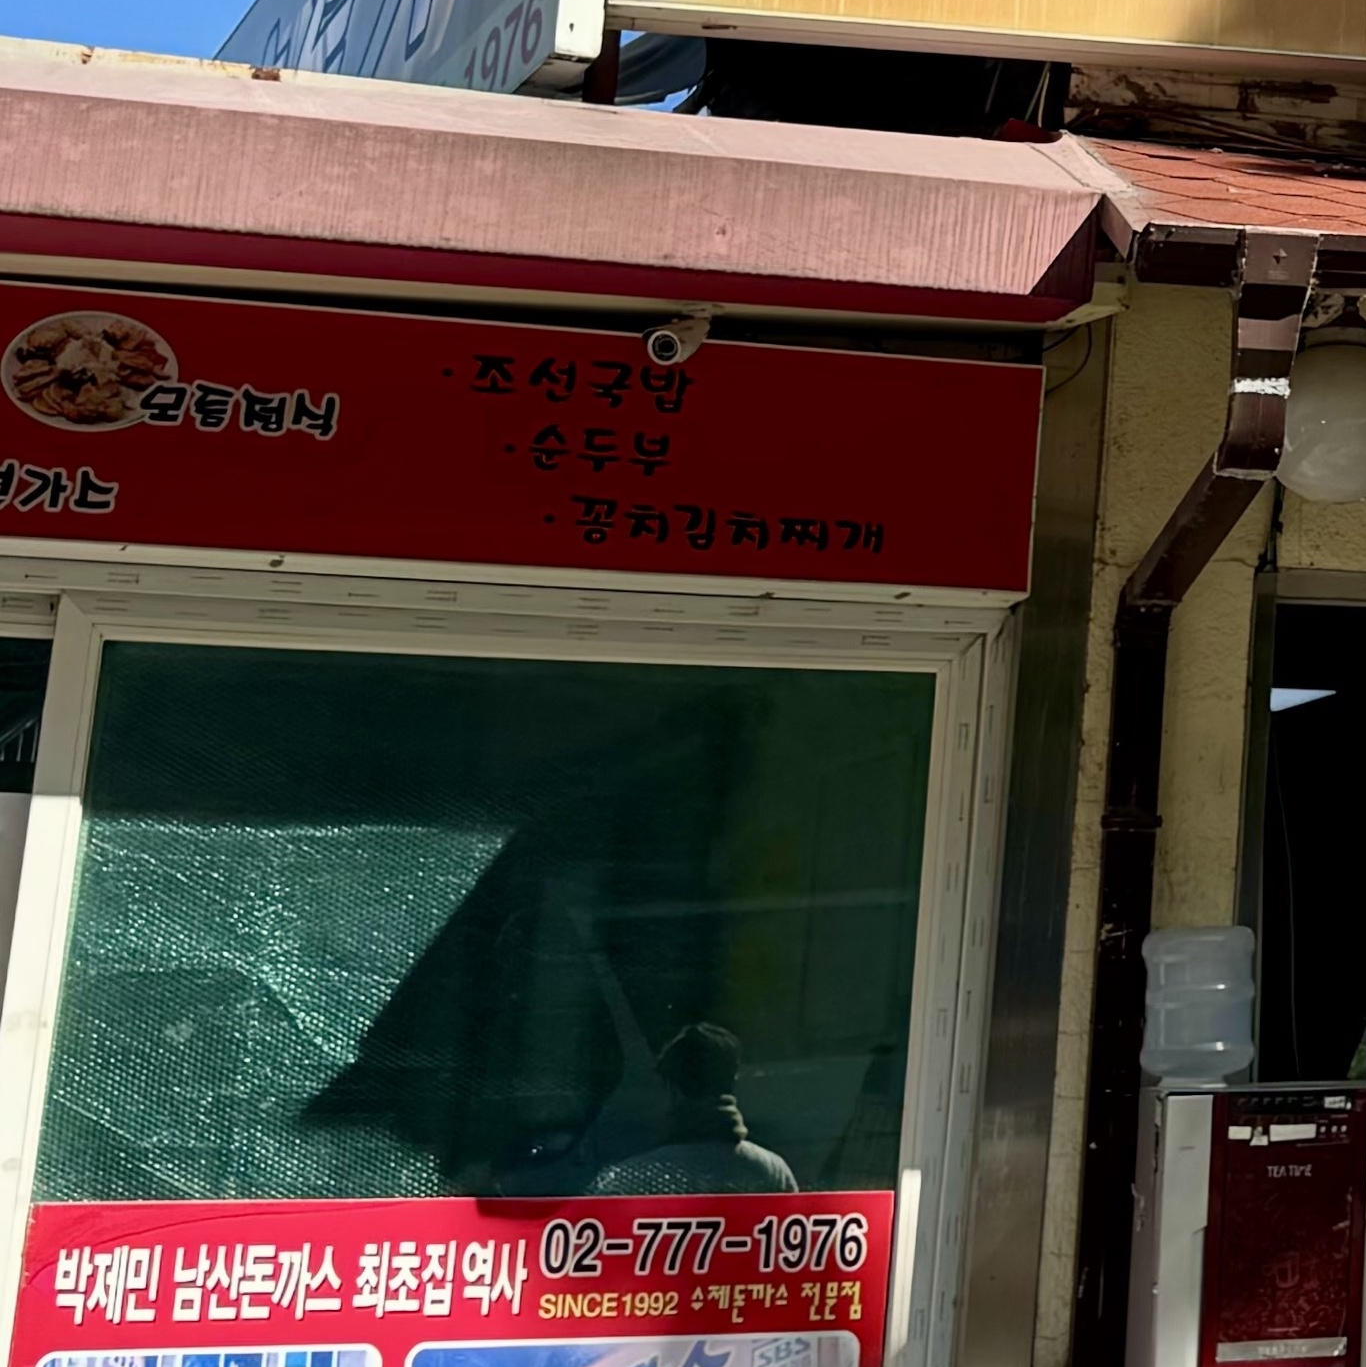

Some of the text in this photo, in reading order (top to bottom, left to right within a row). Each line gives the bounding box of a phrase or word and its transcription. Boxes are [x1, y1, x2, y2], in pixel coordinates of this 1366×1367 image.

[470, 354, 695, 414] 조선국밥
[529, 424, 671, 477] 순두부
[539, 1213, 867, 1278] 02-777-1976
[54, 1238, 528, 1325] 박제민 남산돈까스 최초집 역사
[690, 1284, 788, 1323] 수제돈까스
[800, 1281, 862, 1321] 전문점
